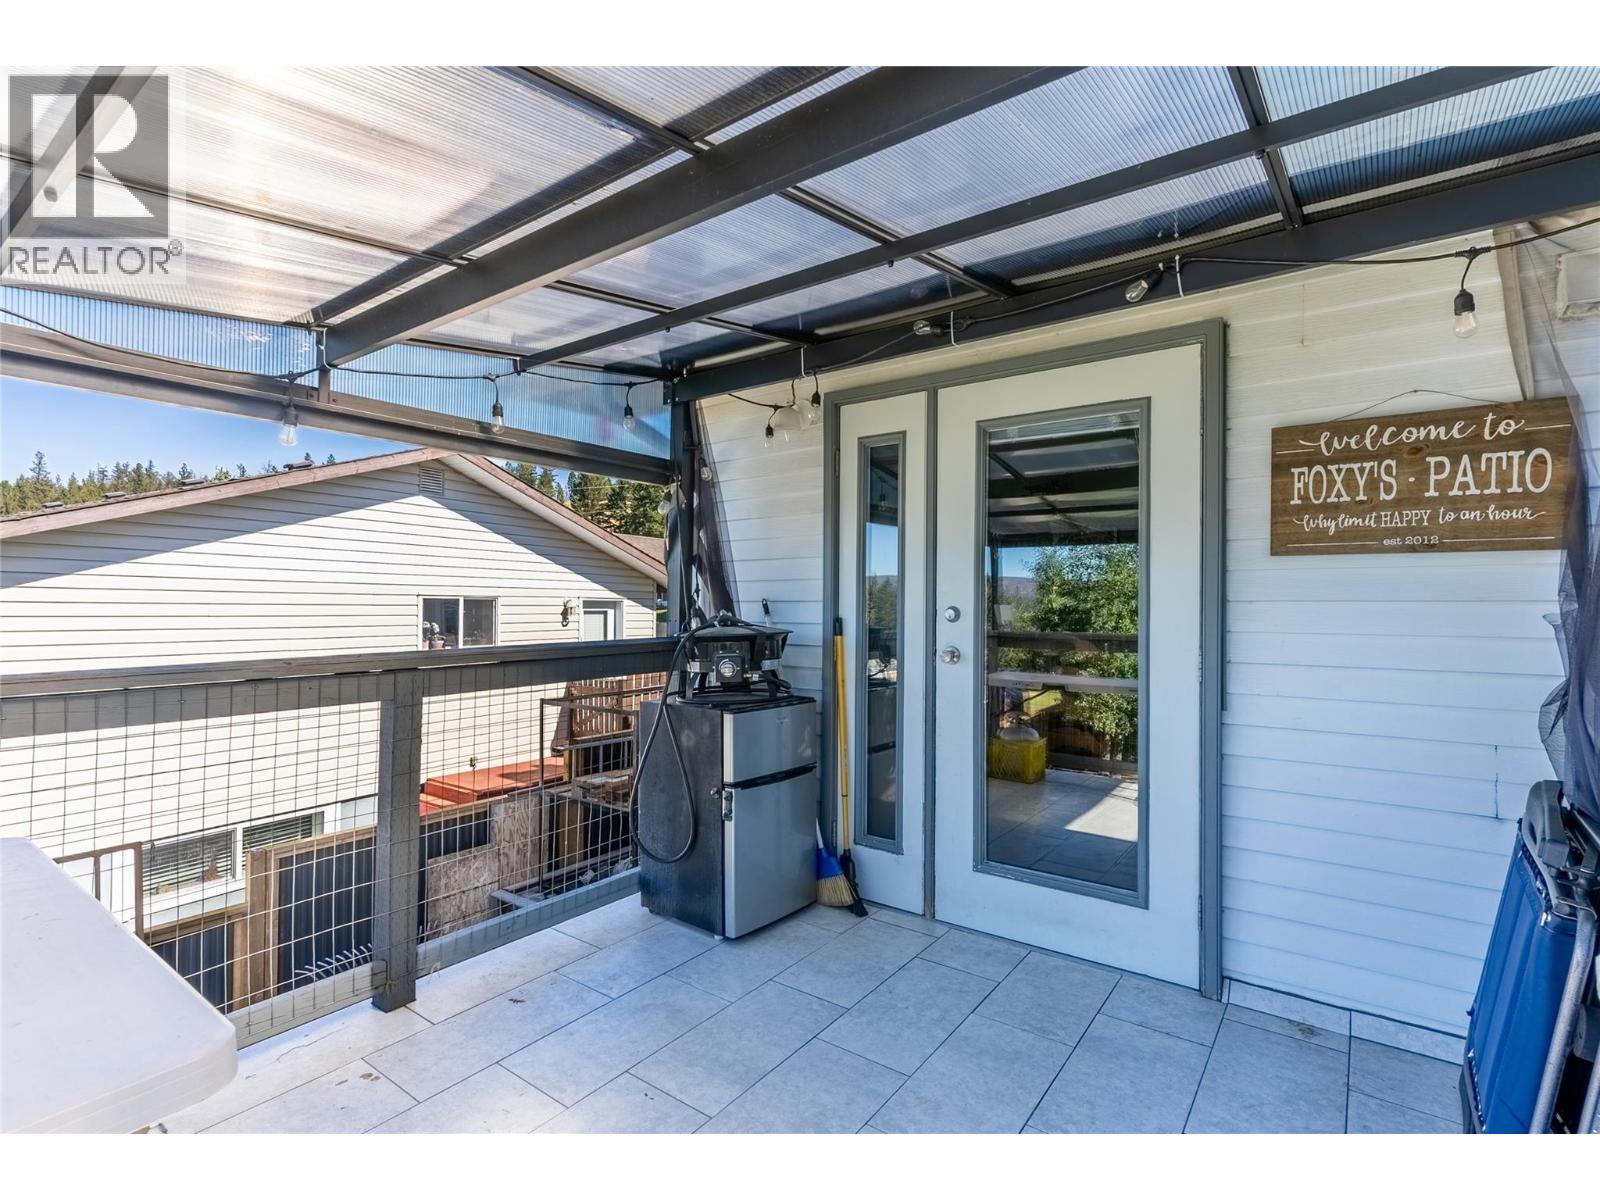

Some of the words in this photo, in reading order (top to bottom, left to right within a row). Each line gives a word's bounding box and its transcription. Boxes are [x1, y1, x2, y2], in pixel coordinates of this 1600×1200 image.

[1484, 411, 1526, 440] to
[1290, 459, 1397, 505] FOXY'S
[1425, 447, 1552, 497] PATIO
[1338, 512, 1377, 529] limit
[1380, 509, 1431, 528] HAPPY
[1438, 506, 1459, 524] to
[1460, 509, 1486, 522] an
[1486, 504, 1547, 521] hour
[1383, 537, 1402, 546] est
[1404, 535, 1439, 545] 2012
